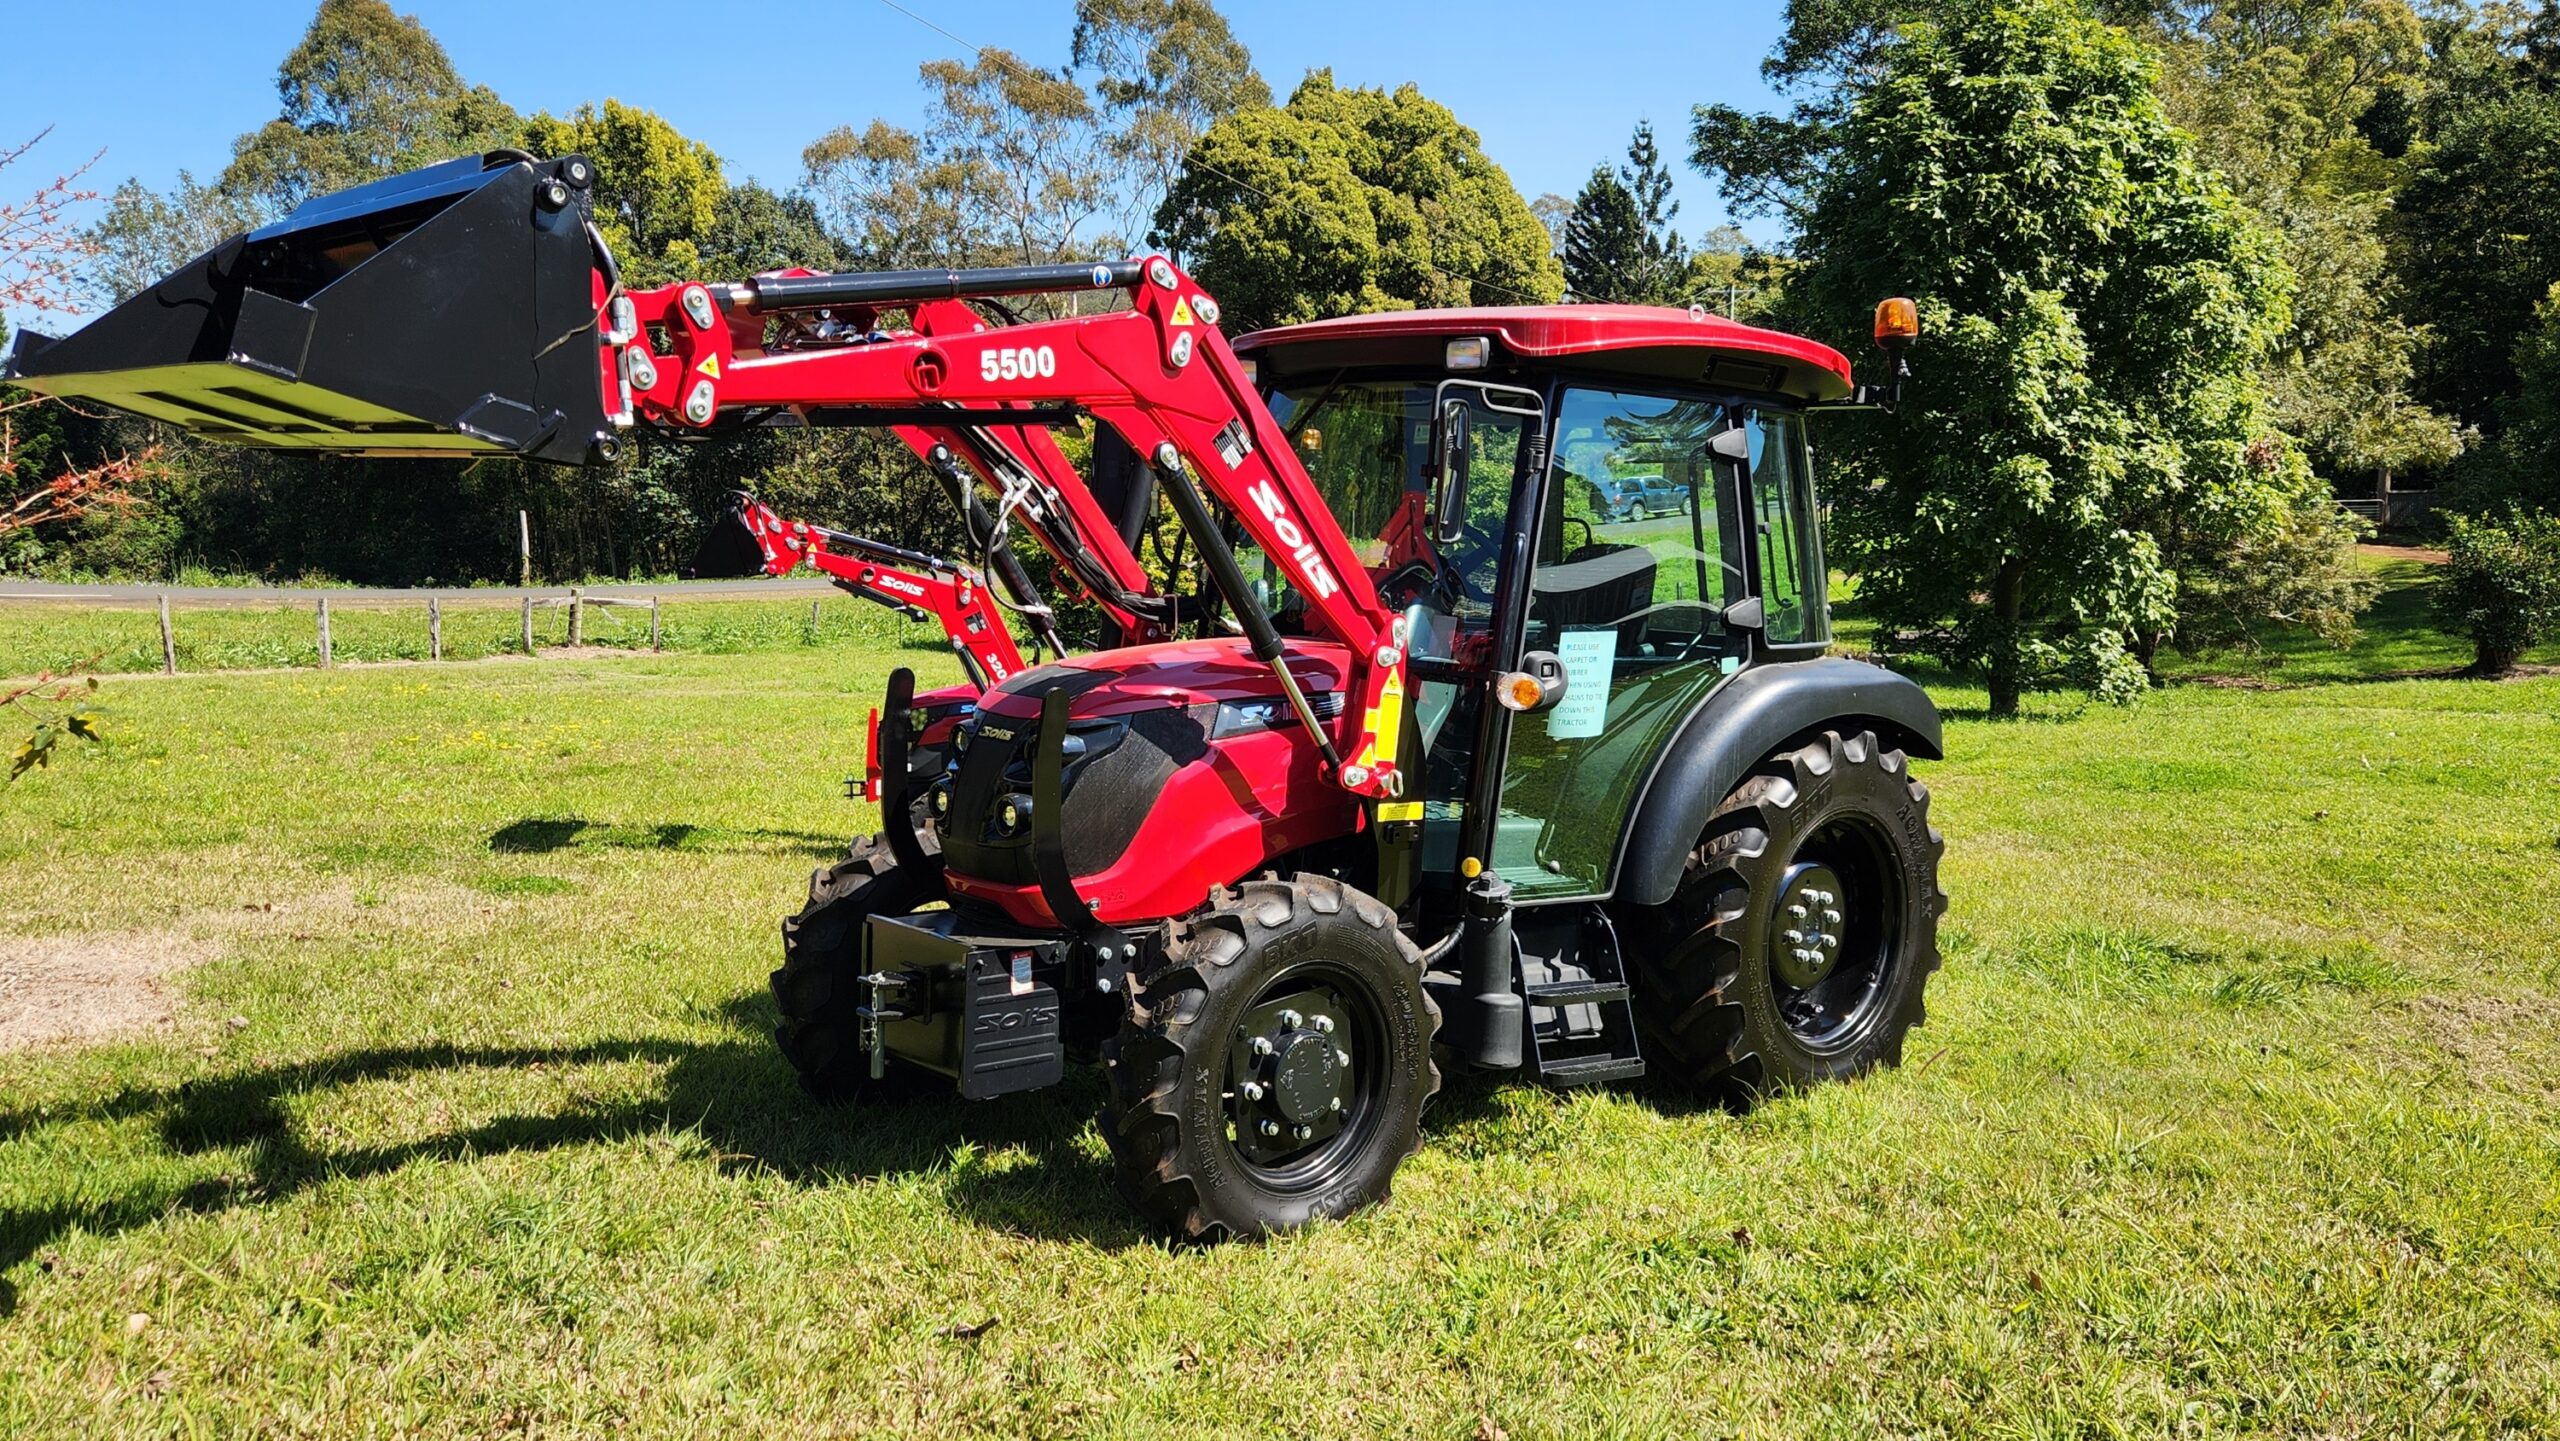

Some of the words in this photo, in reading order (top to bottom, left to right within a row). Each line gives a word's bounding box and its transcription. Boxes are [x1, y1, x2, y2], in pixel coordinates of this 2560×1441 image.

[981, 345, 1056, 382] 5500
[986, 652, 1008, 680] 320
[1565, 656, 1587, 664] CARPET
[1568, 668, 1588, 676] UBBER
